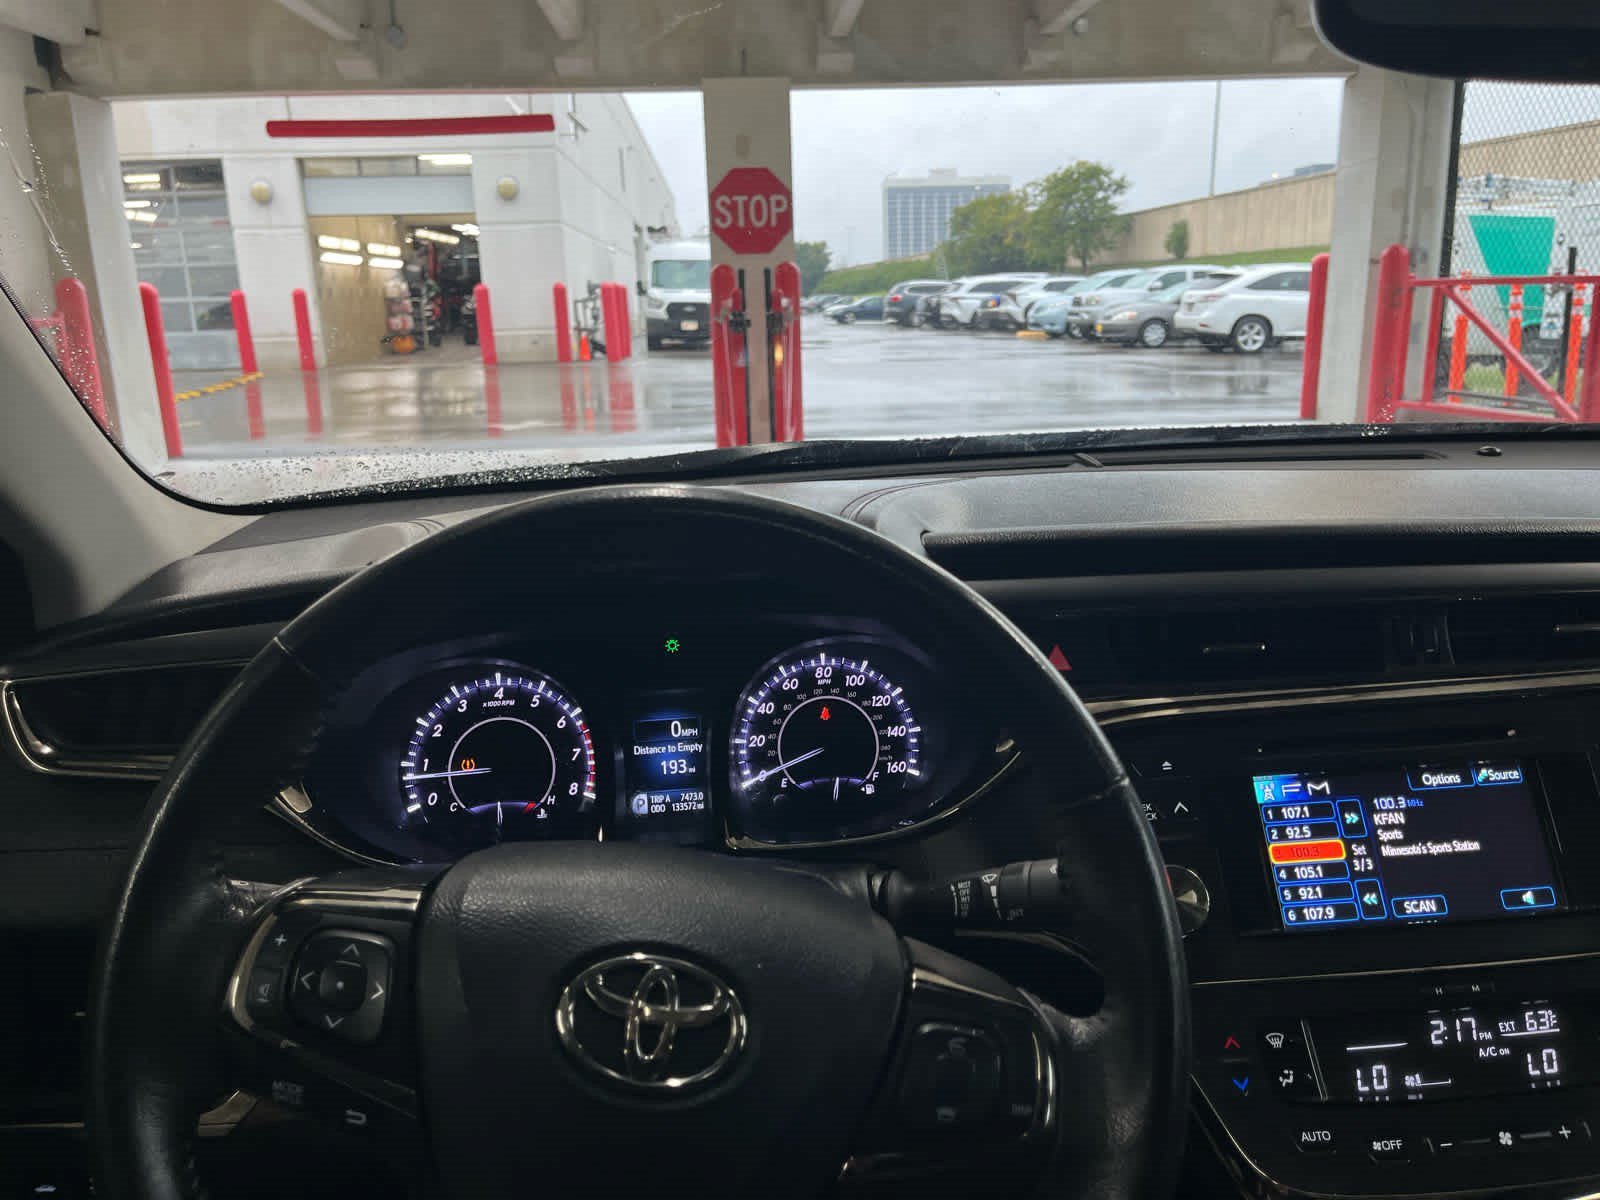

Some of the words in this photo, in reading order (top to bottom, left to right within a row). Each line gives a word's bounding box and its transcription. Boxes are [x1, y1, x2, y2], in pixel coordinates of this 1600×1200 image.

[715, 194, 788, 228] STOP
[815, 667, 832, 678] 80
[783, 679, 798, 690] 60
[846, 675, 864, 686] 100
[495, 688, 504, 699] 4
[458, 700, 467, 712] 3
[530, 695, 540, 707] 5
[872, 695, 890, 706] 120
[757, 702, 774, 714] 40
[557, 717, 566, 728] 6
[432, 725, 442, 737] 2
[671, 721, 681, 737] 0
[682, 728, 698, 736] MPH
[887, 726, 906, 737] 140
[749, 735, 765, 747] 20
[572, 748, 580, 760] 7
[634, 745, 666, 755] Distance
[668, 744, 676, 753] to
[678, 742, 702, 752] Empty
[423, 759, 429, 771] 1
[661, 760, 687, 774] 193
[887, 761, 906, 773] 160
[872, 772, 879, 781] F
[1422, 773, 1460, 786] Options
[1488, 769, 1519, 780] Source
[569, 783, 578, 795] 8
[781, 778, 788, 788] E
[1282, 781, 1330, 797] FM
[428, 793, 438, 805] 0
[547, 795, 555, 805] H
[650, 795, 664, 803] TRIP
[680, 792, 704, 801] 7473.0
[1374, 797, 1406, 809] 100.3
[1407, 799, 1424, 807] MHz
[450, 802, 458, 812] C
[637, 798, 645, 812] P
[672, 802, 697, 811] 133572
[1268, 810, 1273, 819] 1
[1282, 806, 1310, 819] 107.1
[1374, 812, 1405, 825] KFAN
[1271, 830, 1278, 840] 2
[1286, 826, 1311, 839] 92.5
[1378, 829, 1403, 842] Sports
[1290, 846, 1319, 858] 100.3
[1352, 844, 1367, 855] Set
[1381, 842, 1427, 856] Minnesota's
[1427, 842, 1452, 855] Sports
[1452, 841, 1480, 851] Station
[1353, 858, 1373, 872] 3/3
[1280, 869, 1287, 880] 4
[1294, 866, 1323, 878] 105.1
[1284, 890, 1291, 900] 5
[1298, 886, 1322, 899] 92.1
[1288, 910, 1296, 920] 6
[1303, 906, 1334, 920] 107.9
[1404, 901, 1436, 913] SCAN
[1430, 1017, 1477, 1044] 2:17
[1479, 1032, 1492, 1040] PM
[1498, 1021, 1515, 1032] EXT
[1479, 1046, 1497, 1057] A/C
[1527, 1049, 1558, 1075] LO
[1356, 1064, 1387, 1091] LO
[1302, 1131, 1331, 1142] AUTO
[1382, 1140, 1402, 1151] OFF
